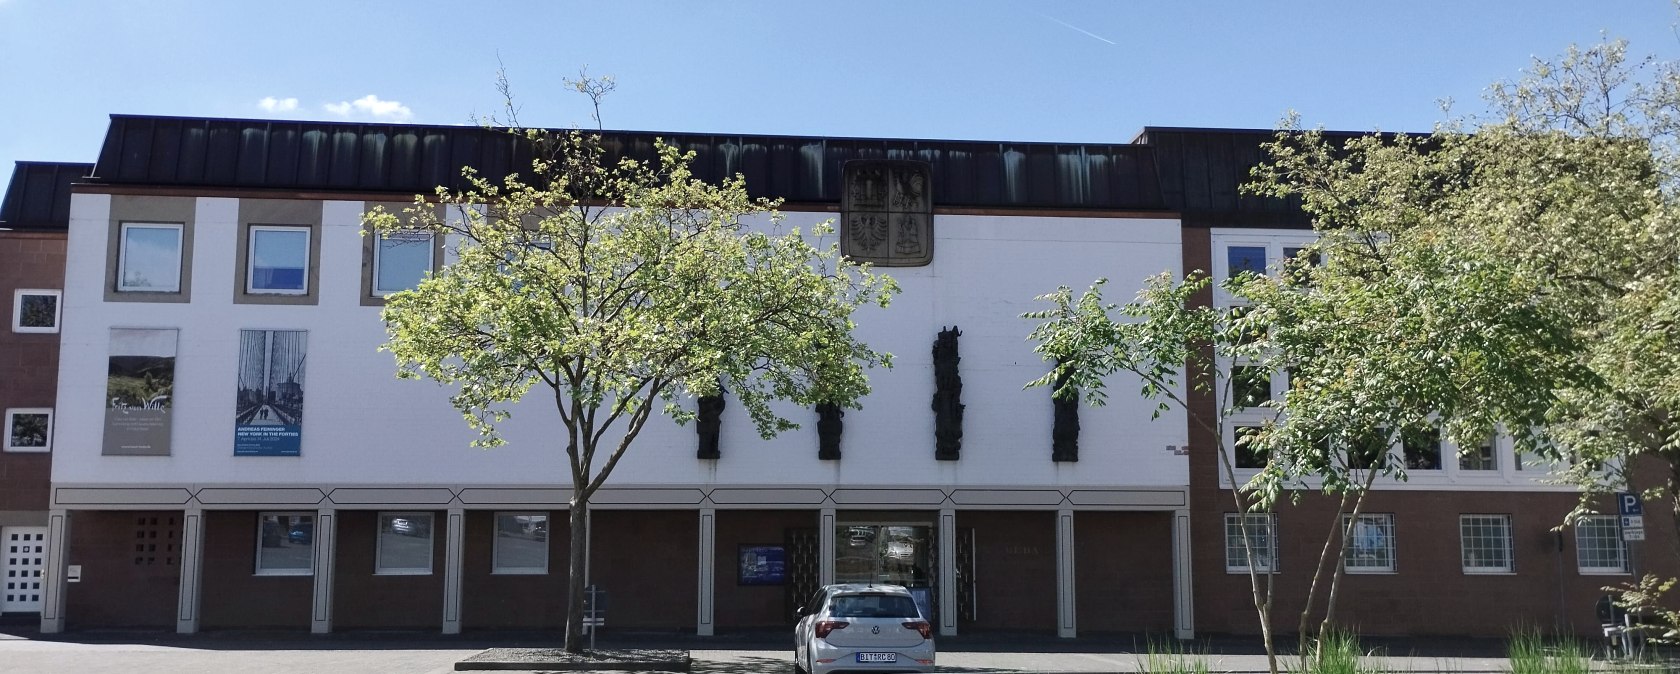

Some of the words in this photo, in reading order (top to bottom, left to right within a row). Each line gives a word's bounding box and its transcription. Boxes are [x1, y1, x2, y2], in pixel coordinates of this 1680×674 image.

[111, 397, 129, 414] Fritz
[142, 395, 167, 414] Wille
[1624, 495, 1636, 513] P
[860, 653, 874, 661] BIT
